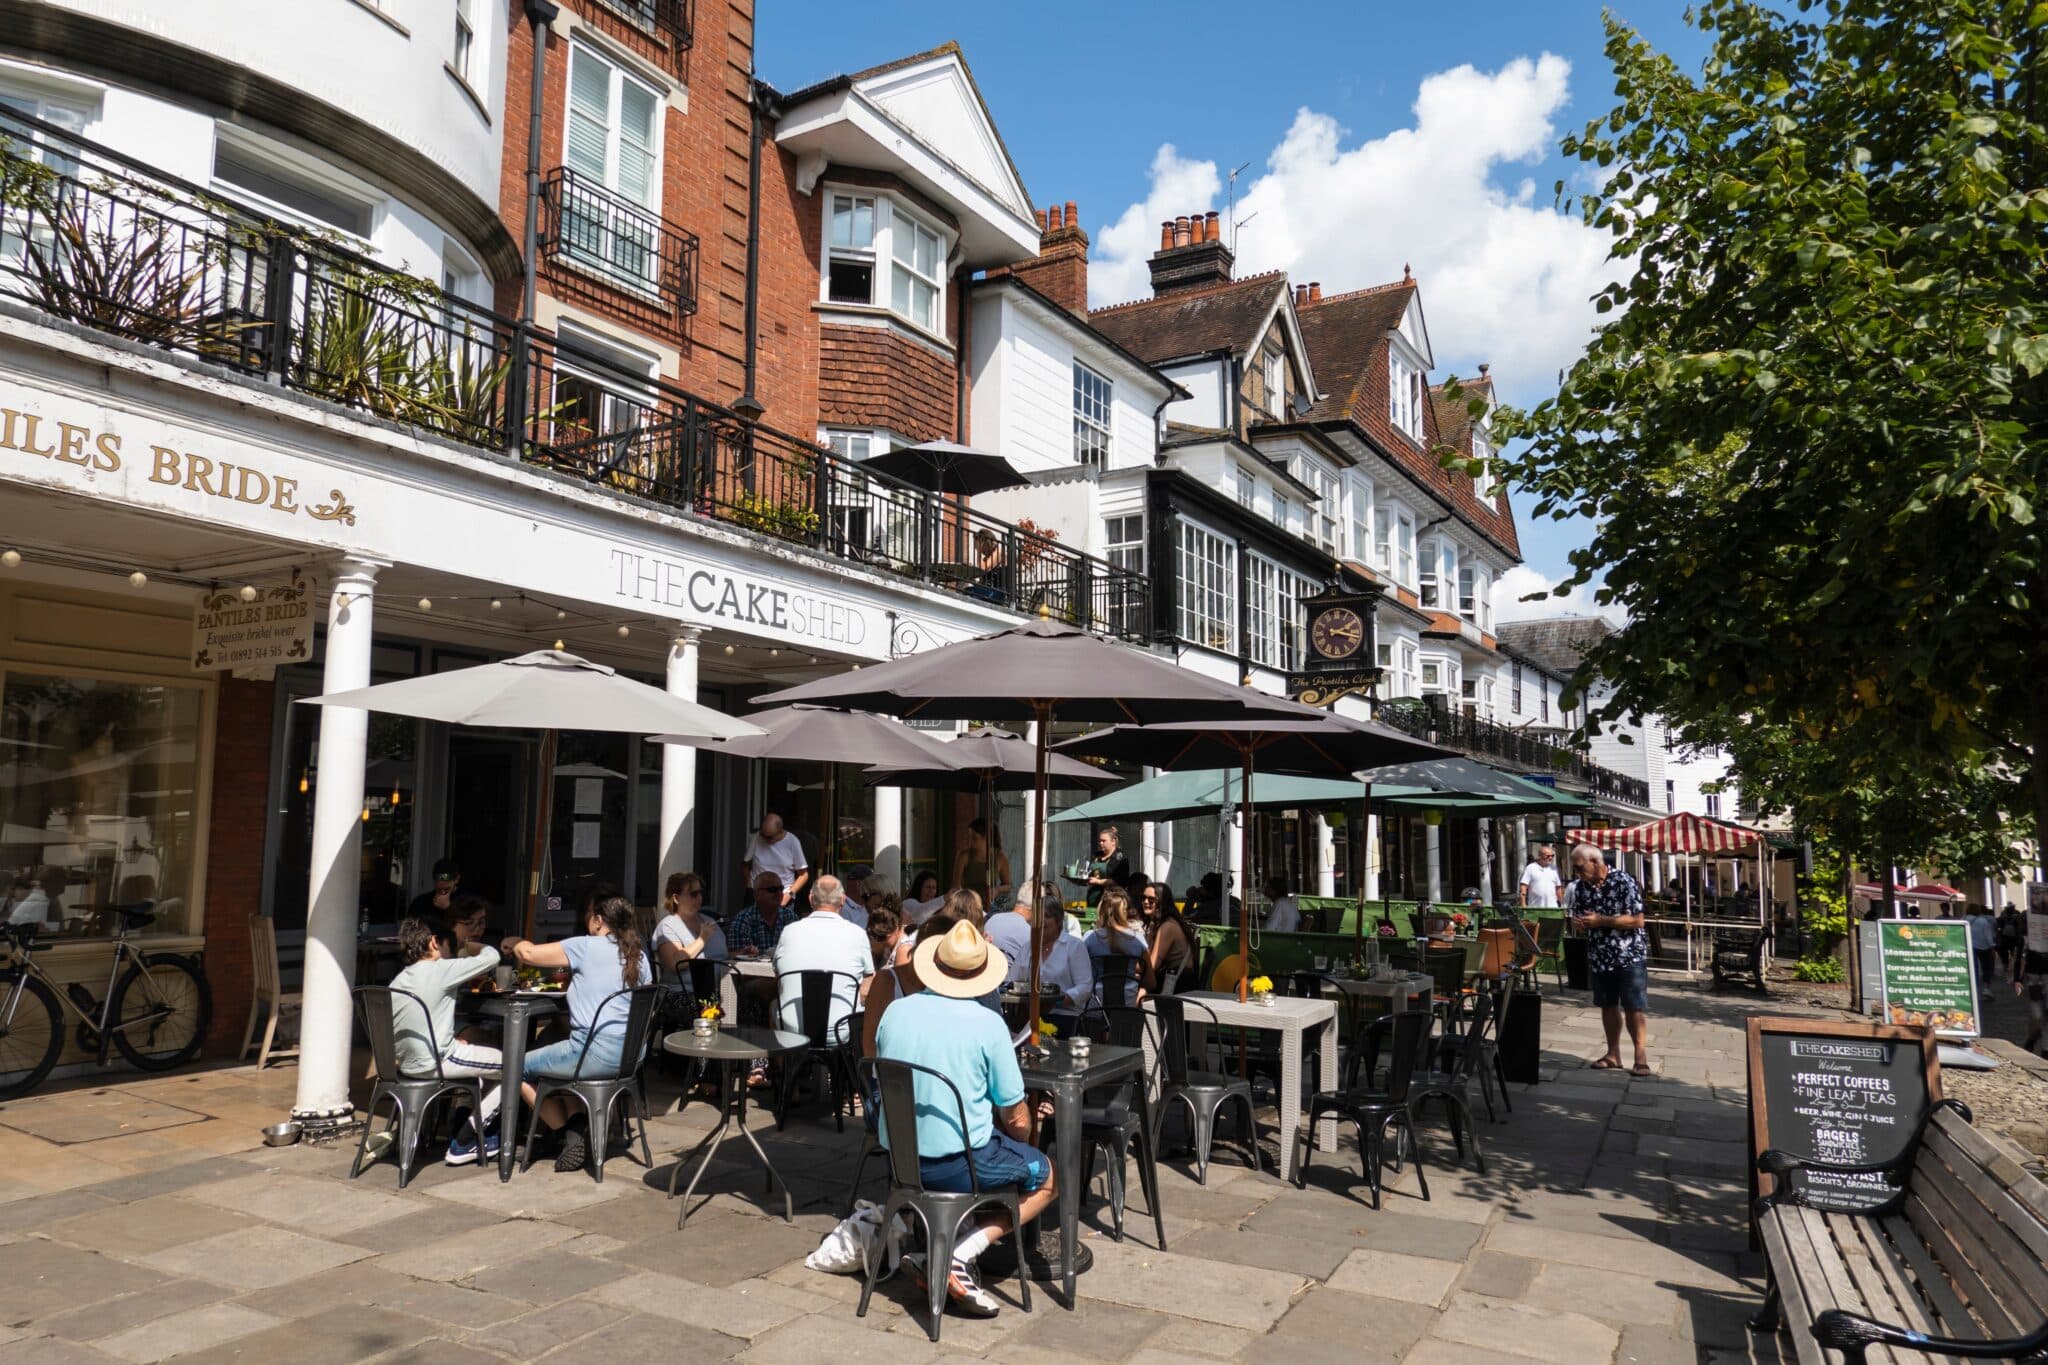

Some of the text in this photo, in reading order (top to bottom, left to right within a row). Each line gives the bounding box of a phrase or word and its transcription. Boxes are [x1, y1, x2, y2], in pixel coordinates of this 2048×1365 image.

[0, 408, 298, 514] ILES BRIDE
[198, 601, 308, 629] PANTILES BRIDE
[206, 626, 296, 648] Exquisite bridal wear
[230, 649, 252, 661] 01892
[255, 647, 268, 657] 514
[270, 646, 282, 656] 515
[1291, 673, 1377, 686] The Pantiles Clock
[1909, 940, 1936, 948] Serving
[1884, 949, 1967, 958] Monmouth Coffee
[1886, 964, 1926, 973] European
[1947, 966, 1967, 974] with
[1888, 986, 1913, 994] Great
[1945, 988, 1969, 997] Beers
[1913, 998, 1956, 1006] Cocktails
[1797, 1073, 1890, 1091] PERFECT COFFEES
[1828, 1089, 1857, 1100] LEAF
[1861, 1091, 1896, 1105] TEAS
[1869, 1115, 1895, 1125] JUICE
[1816, 1129, 1859, 1142] BAGELS
[1818, 1147, 1862, 1159] SALADS
[1846, 1180, 1889, 1192] BROWNIES
